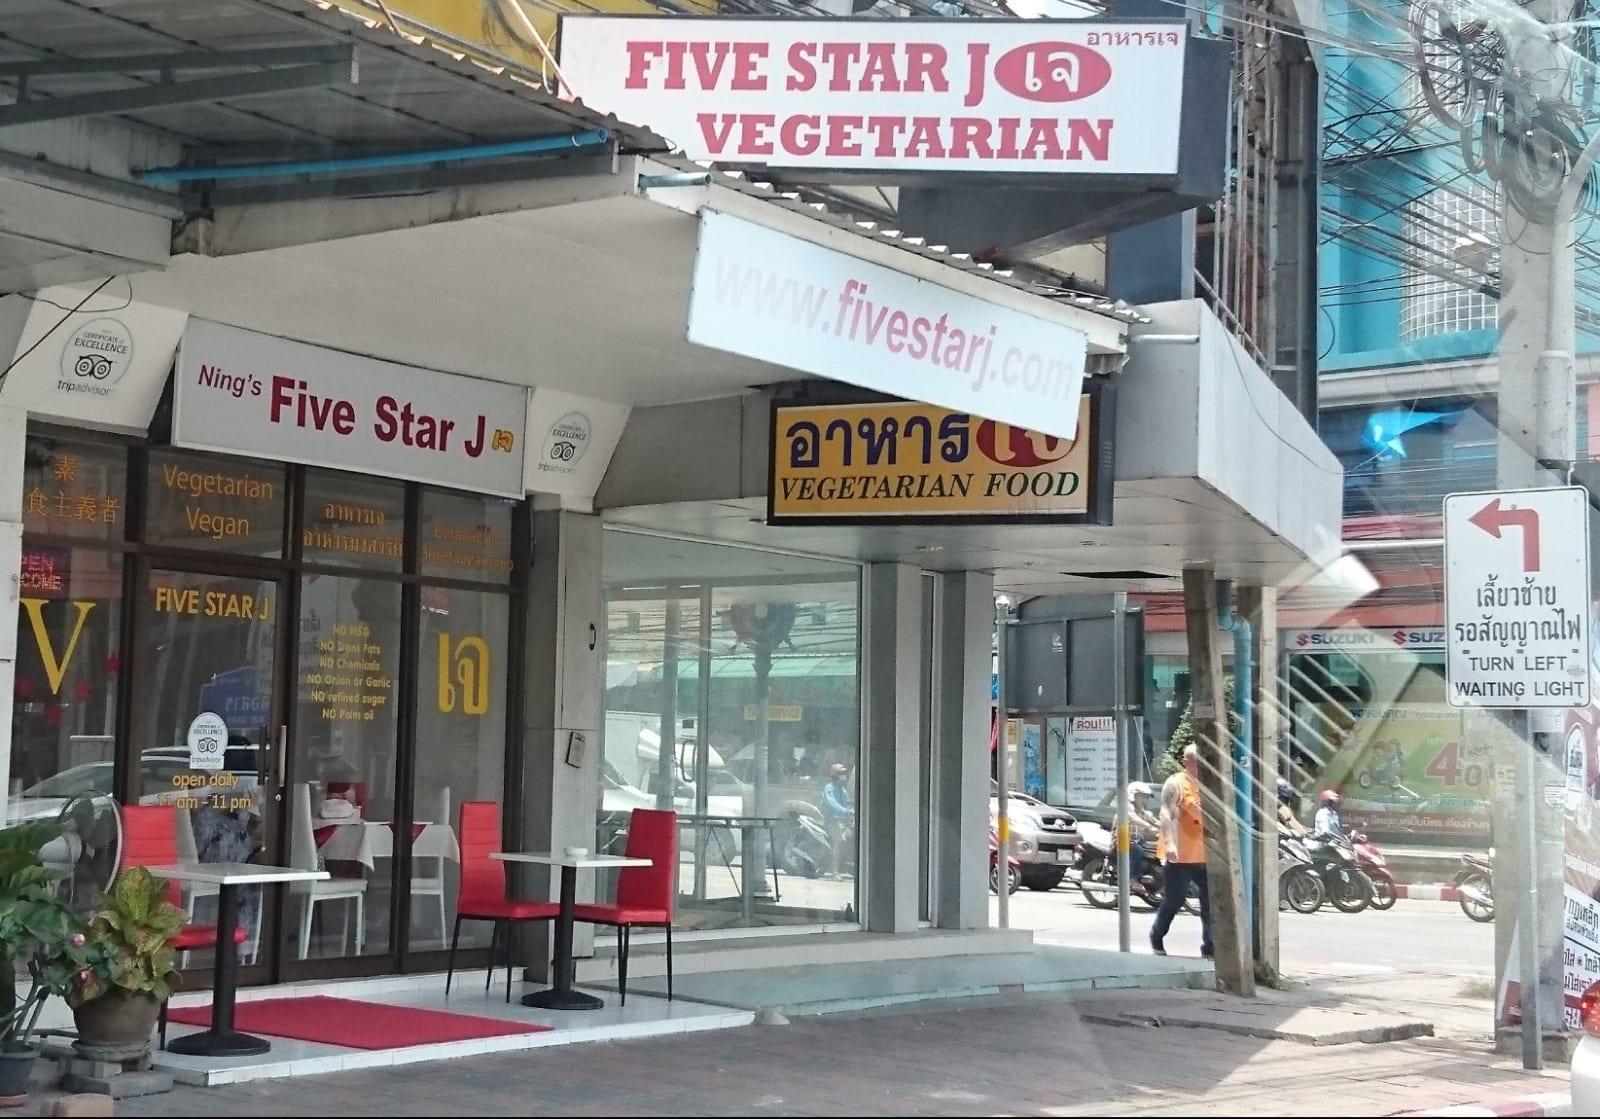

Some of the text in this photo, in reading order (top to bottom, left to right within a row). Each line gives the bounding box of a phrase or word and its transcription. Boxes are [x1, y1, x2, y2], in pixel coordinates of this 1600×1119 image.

[1087, 31, 1179, 46] อาหารเจ
[625, 41, 990, 107] FIVE STAR J
[1025, 51, 1080, 93] เจ
[697, 113, 1114, 162] VEGETARIAN
[714, 256, 1074, 401] www.fivestarj.com
[74, 338, 129, 354] EXCELLENCE
[198, 364, 486, 458] Ning's Five Star J
[786, 413, 971, 469] อาหาร
[54, 453, 78, 482] 素
[162, 463, 273, 499] Vegetarian
[780, 471, 1080, 501] VEGETARIAN FOOD
[26, 486, 121, 524] 食主義者
[185, 505, 250, 540] Vegan
[156, 587, 269, 620] FIVE STAR J
[1477, 573, 1557, 608] เลี้ยวซ้าย
[333, 624, 347, 637] NO
[1311, 632, 1375, 645] SUZUKI
[1455, 608, 1582, 648] รอสัญญาณไฟ
[20, 597, 97, 695] V
[320, 640, 334, 652] NO
[320, 657, 334, 669] NO
[438, 633, 489, 715] เจ
[1469, 656, 1567, 672] TURN LEFT
[307, 673, 391, 688] NO Onion or Garlic
[1455, 681, 1585, 698] WAITING LIGHT
[311, 690, 386, 706] NO refined sugar
[322, 707, 336, 719] NO
[172, 772, 238, 790] open daily
[176, 796, 198, 809] am
[230, 794, 251, 812] pm
